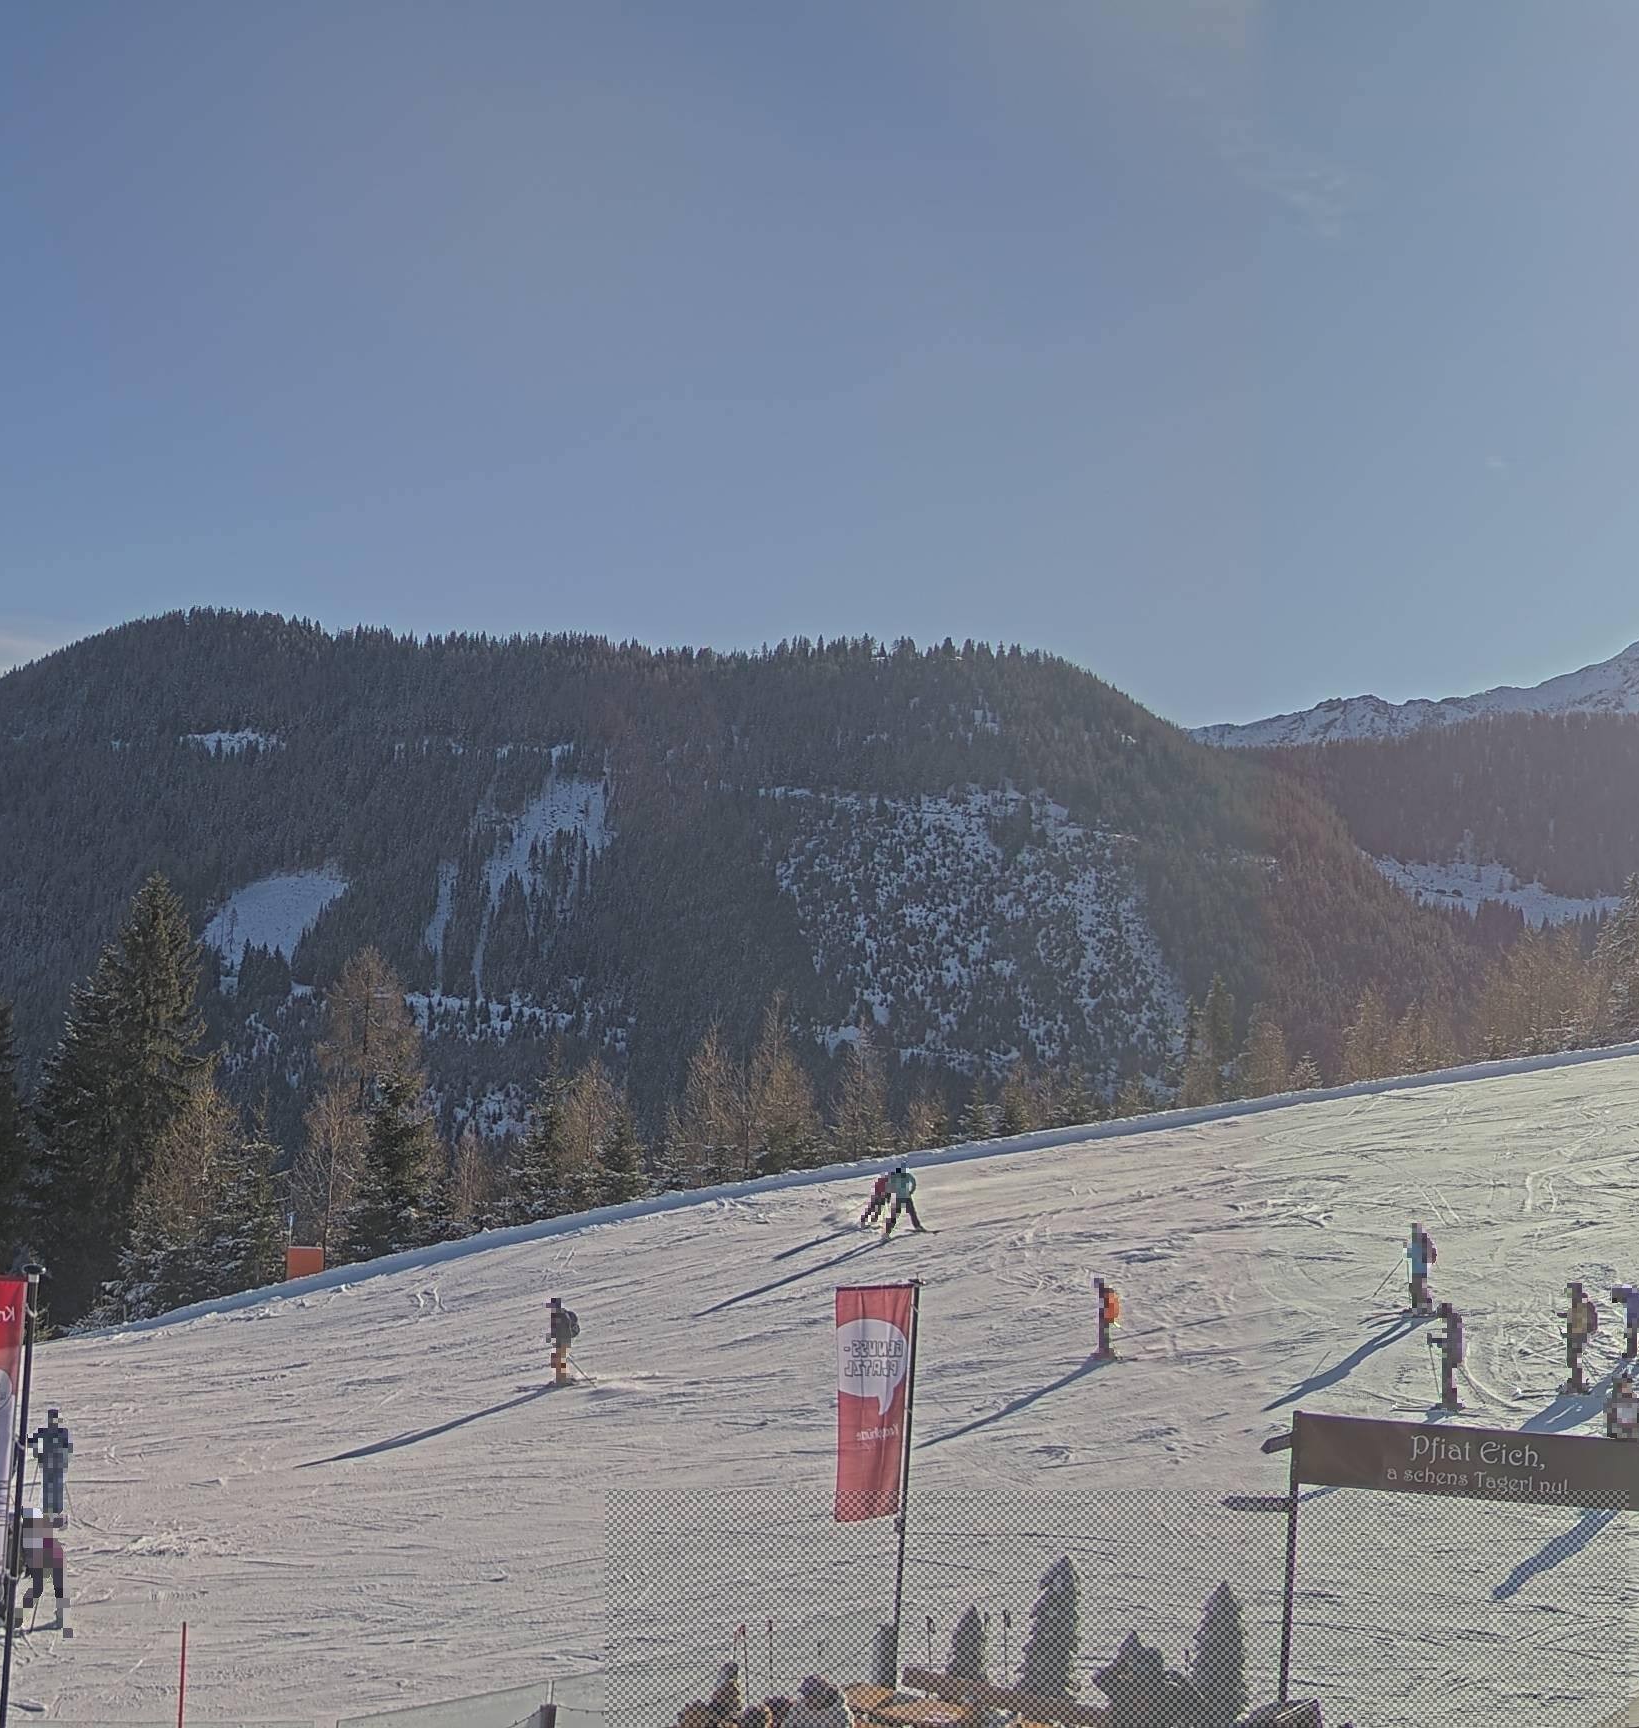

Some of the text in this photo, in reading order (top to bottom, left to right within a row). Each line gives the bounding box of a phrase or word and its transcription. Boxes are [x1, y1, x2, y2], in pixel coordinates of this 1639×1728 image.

[1409, 1435, 1545, 1470] Pfiat Eich,
[1387, 1468, 1397, 1480] a
[1403, 1468, 1468, 1486] schens
[1474, 1472, 1533, 1494] Tagerl
